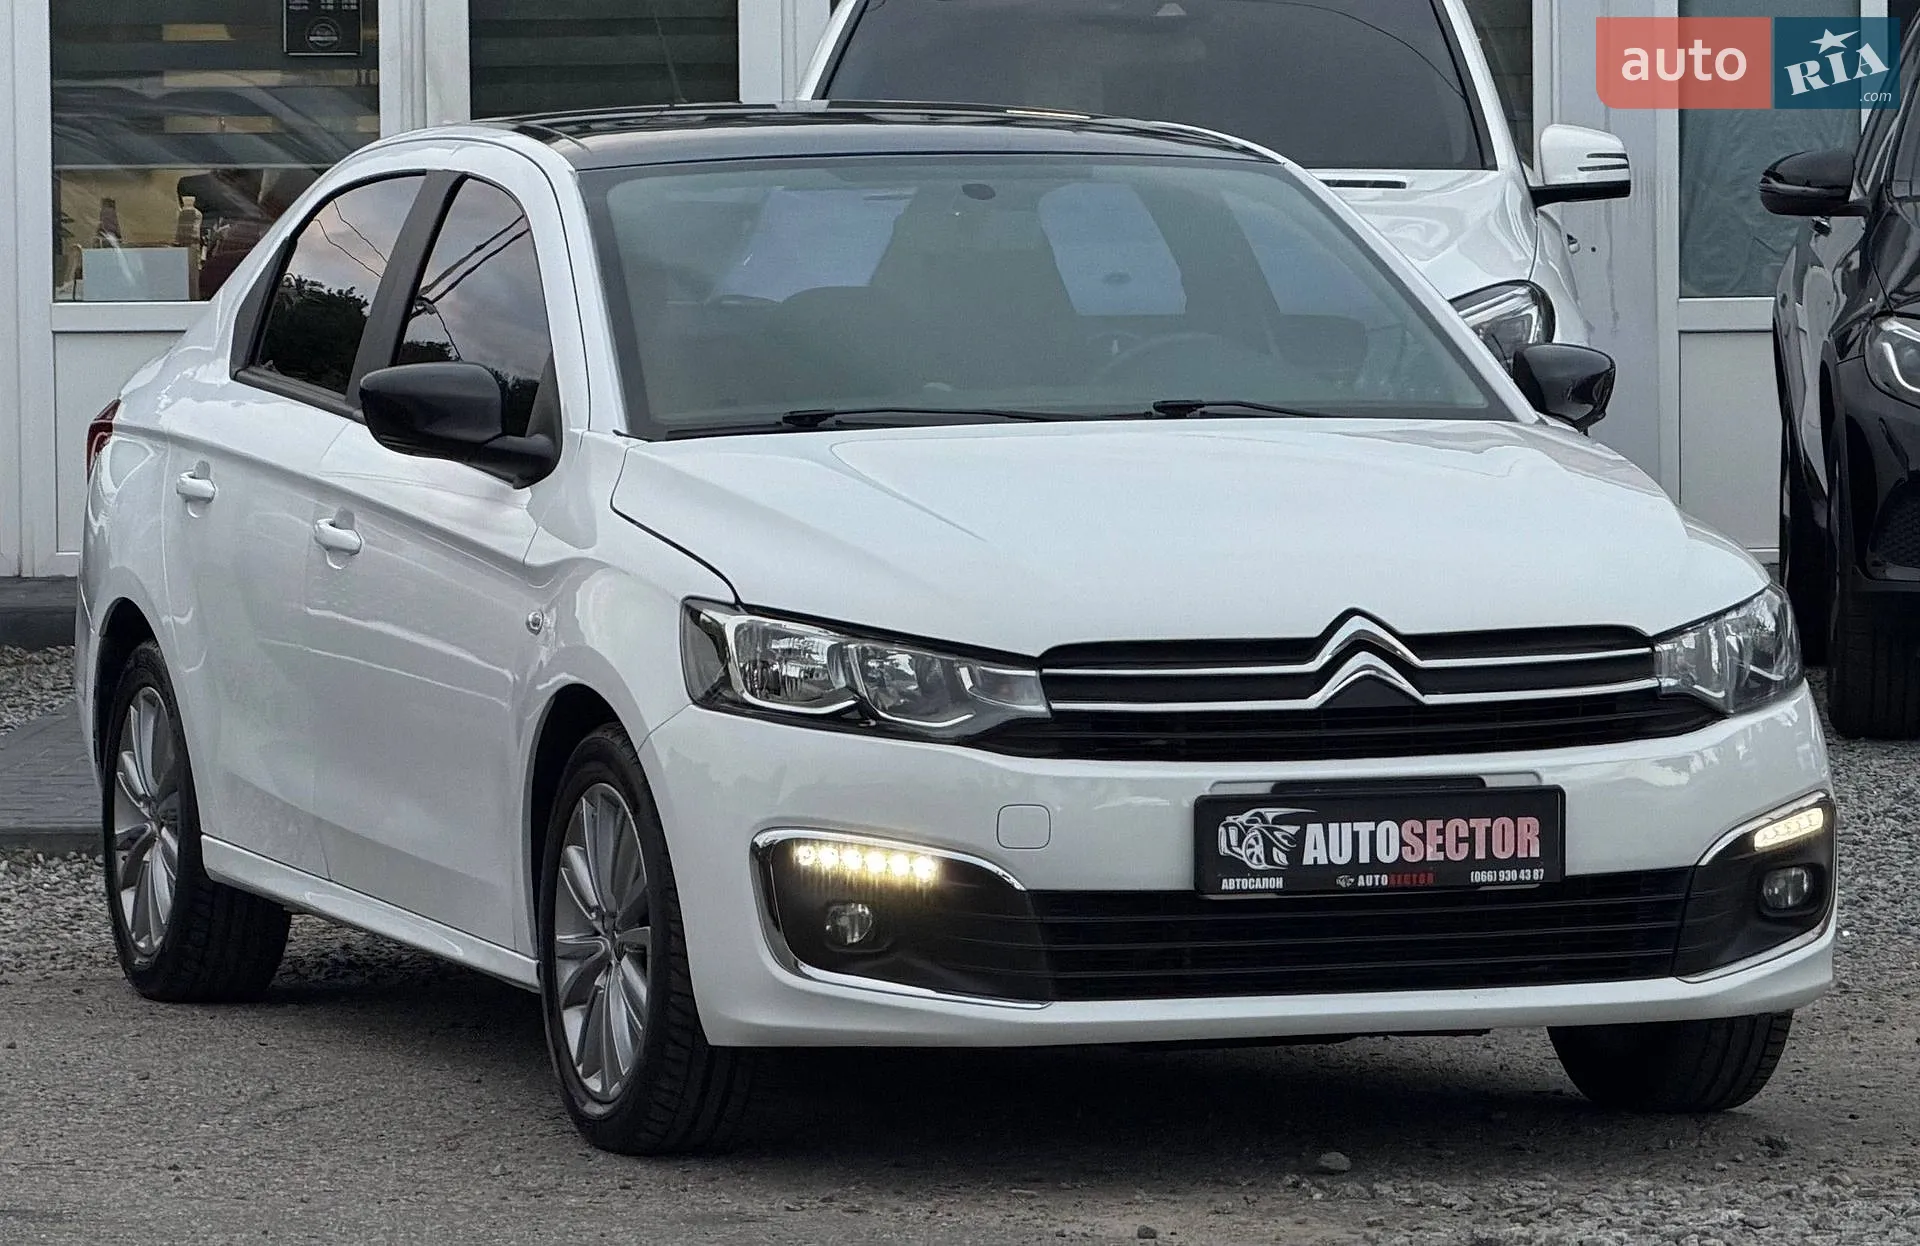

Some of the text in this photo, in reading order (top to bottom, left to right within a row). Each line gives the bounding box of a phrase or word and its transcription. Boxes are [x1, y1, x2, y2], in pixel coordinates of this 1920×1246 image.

[1302, 817, 1541, 866] AUTOSECTOR
[1470, 870, 1497, 882] (066)
[1498, 869, 1517, 881] 930
[1519, 868, 1531, 880] 43
[1221, 877, 1284, 890] АВТОСАЛОН
